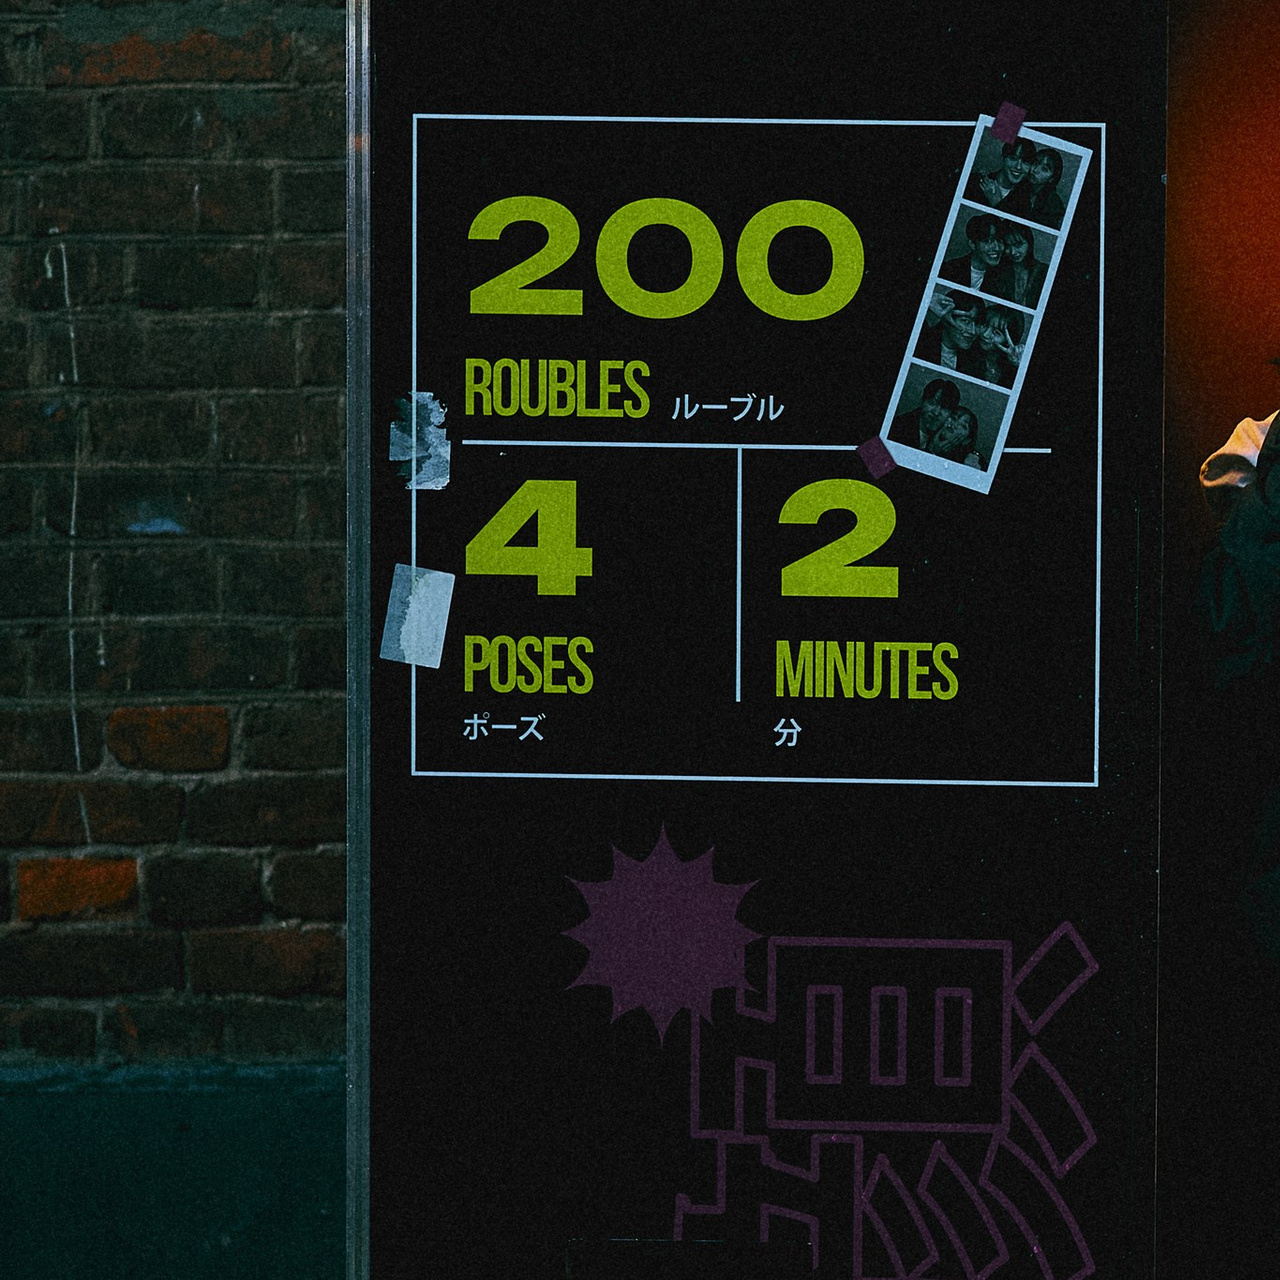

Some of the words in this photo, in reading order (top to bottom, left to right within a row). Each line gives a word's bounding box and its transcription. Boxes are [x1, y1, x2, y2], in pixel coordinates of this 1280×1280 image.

[467, 195, 866, 322] 200
[464, 357, 651, 419] ROUBLES
[671, 392, 785, 422] ルーブル
[465, 479, 594, 596] 4
[778, 478, 900, 599] 2
[463, 634, 595, 695] POSES
[775, 639, 960, 701] MINUTES
[462, 712, 545, 742] ポーズ
[773, 717, 802, 747] 分
